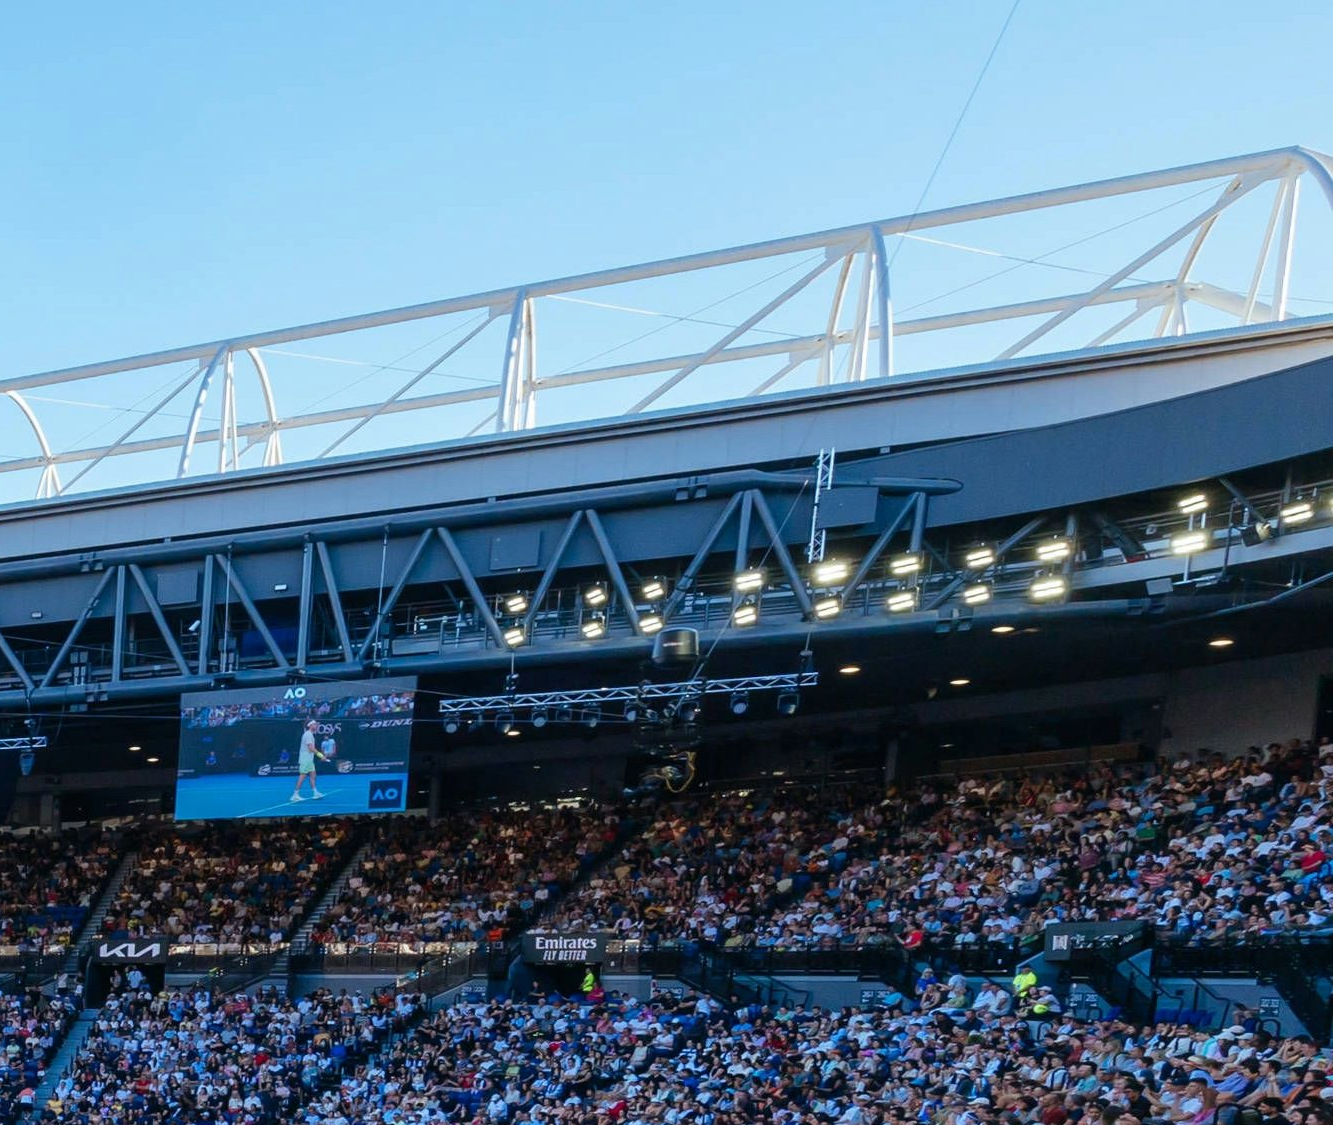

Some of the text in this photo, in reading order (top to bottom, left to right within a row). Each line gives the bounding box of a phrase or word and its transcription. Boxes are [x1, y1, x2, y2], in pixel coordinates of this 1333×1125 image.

[372, 788, 398, 800] AO
[535, 936, 598, 950] Emirates
[99, 942, 160, 958] KIA
[542, 949, 588, 961] FLY BETTER
